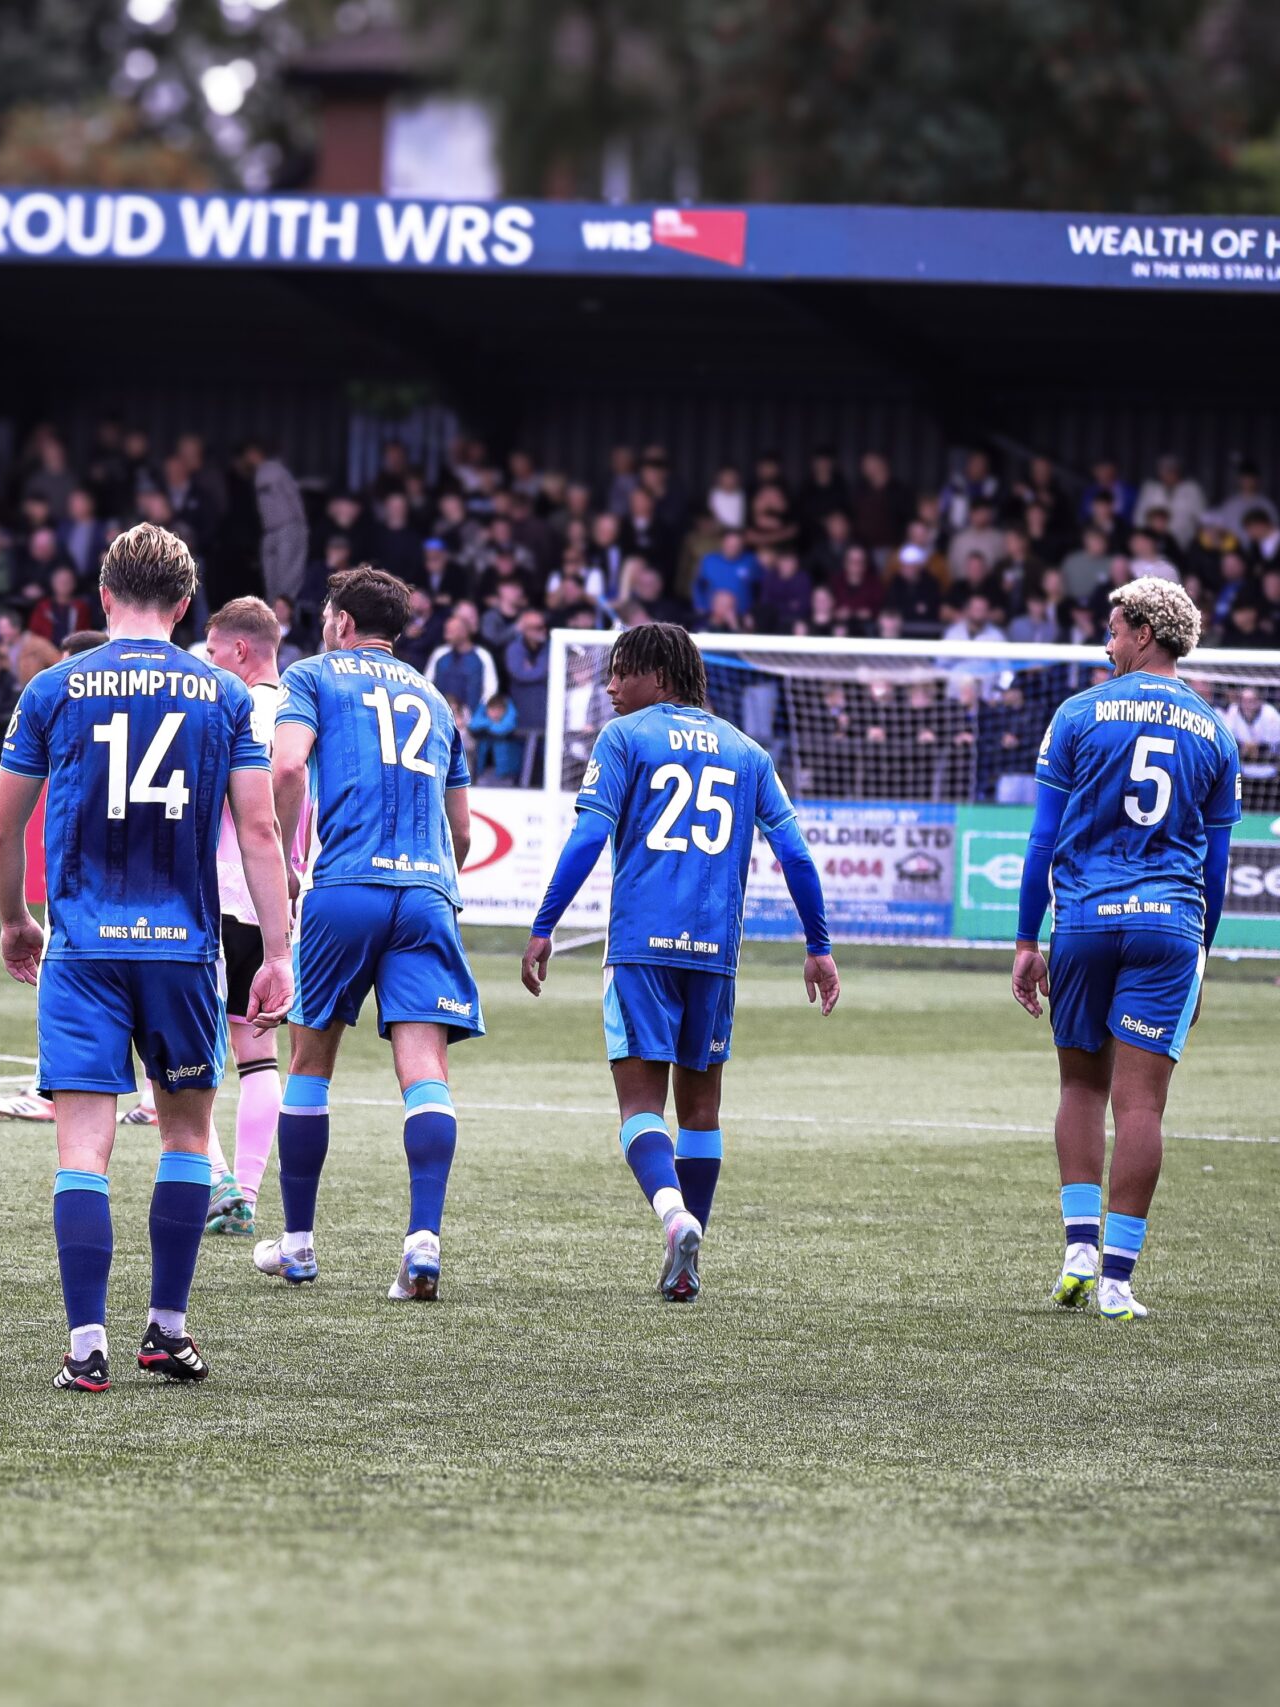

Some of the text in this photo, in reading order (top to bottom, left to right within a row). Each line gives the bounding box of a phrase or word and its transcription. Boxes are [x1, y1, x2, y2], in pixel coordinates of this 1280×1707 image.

[180, 198, 358, 260] WITH
[376, 203, 534, 265] WRS
[581, 220, 652, 250] WRS
[1067, 225, 1204, 257] WEALTH
[1211, 228, 1259, 258] OF
[1131, 262, 1150, 277] IN
[1152, 262, 1181, 278] THE
[1183, 263, 1220, 279] WRS
[1222, 264, 1265, 280] STAR
[68, 669, 217, 702] SHRIMPTON
[362, 685, 436, 777] 12
[1095, 700, 1216, 742] BORTHWICK-JACKSON
[668, 729, 720, 755] DYER
[93, 712, 189, 819] 14
[1124, 736, 1175, 827] 5
[646, 763, 736, 855] 25
[803, 828, 951, 849] OLDING LTD
[371, 856, 394, 870] KINGS
[394, 858, 414, 872] WILL
[1097, 902, 1171, 916] KINGS WILL DREAM
[99, 925, 187, 941] KINGS WILL DREAM
[648, 936, 719, 954] KINGS WILL DREAM
[437, 996, 472, 1016] Releaf
[1120, 1014, 1164, 1040] Releaf
